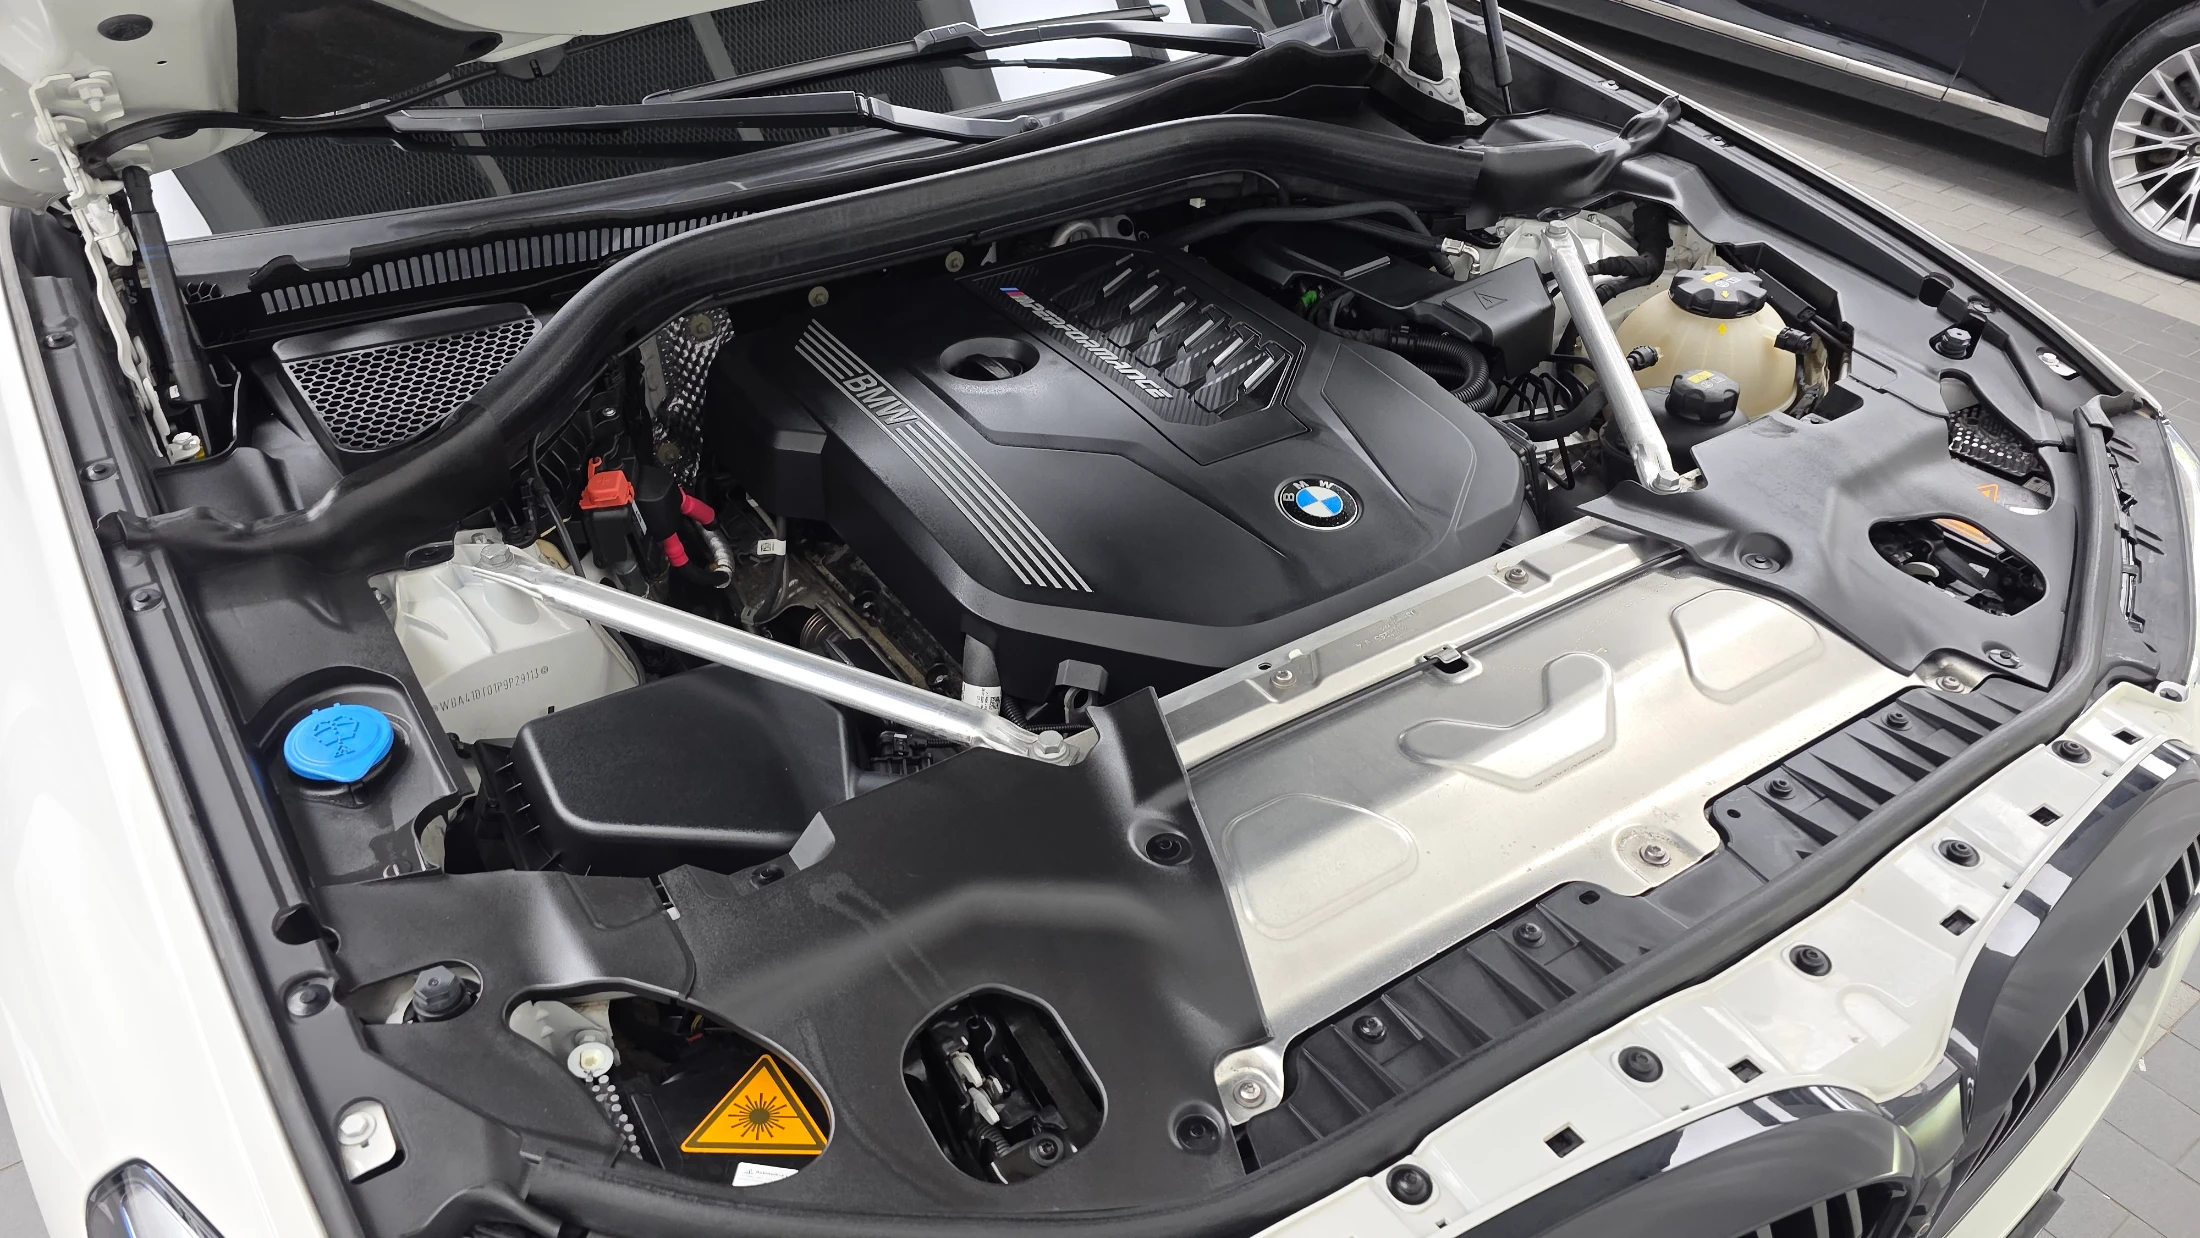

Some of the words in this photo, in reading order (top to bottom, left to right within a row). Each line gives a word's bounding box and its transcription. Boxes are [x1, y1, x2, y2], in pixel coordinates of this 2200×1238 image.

[1028, 303, 1173, 399] PERFORMANCE
[843, 374, 917, 425] BMW
[1283, 480, 1335, 501] BMW
